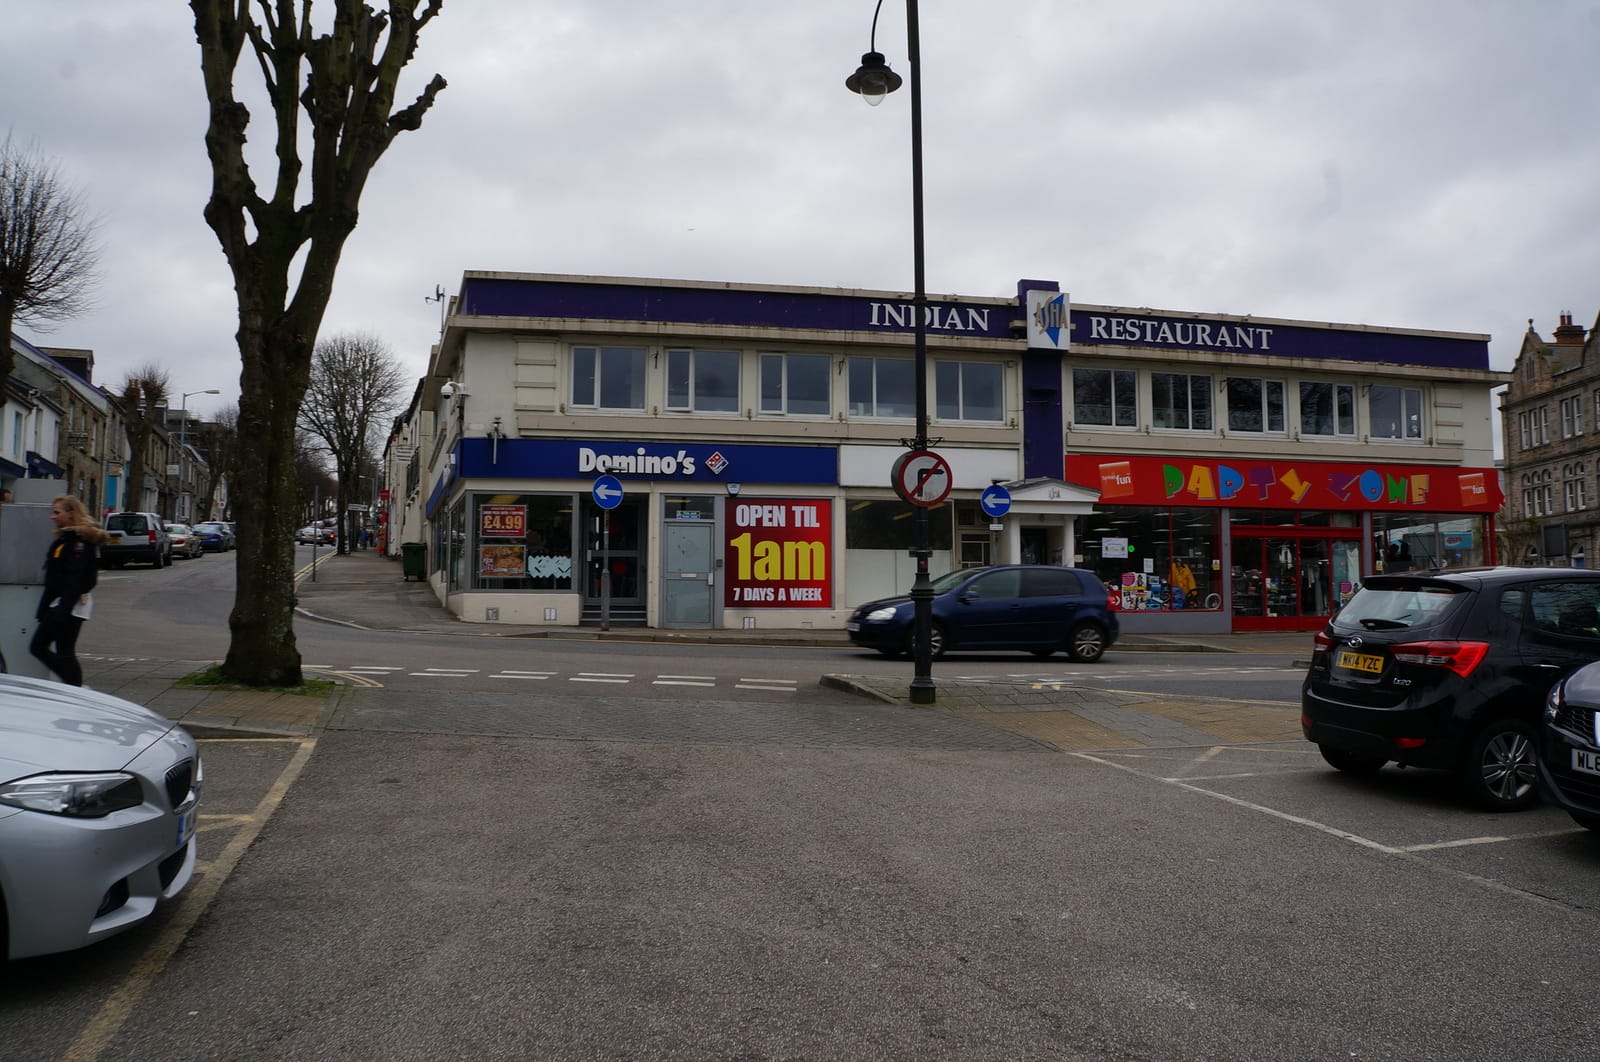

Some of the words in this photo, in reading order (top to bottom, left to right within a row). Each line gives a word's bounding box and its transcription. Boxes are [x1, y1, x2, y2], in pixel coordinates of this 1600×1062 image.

[869, 302, 990, 331] INDIAN
[1090, 316, 1273, 350] RESTAURANT
[1034, 296, 1068, 335] ASHA
[579, 447, 696, 475] Domino's
[1116, 473, 1132, 486] fun
[1162, 463, 1312, 505] PARTY
[1327, 468, 1430, 505] ZONE
[483, 515, 522, 529] £4.99
[736, 504, 786, 527] OPEN
[792, 505, 820, 528] TIL
[730, 532, 826, 581] 1am
[733, 587, 741, 601] 7
[743, 587, 775, 601] DAYS
[777, 587, 787, 601] A
[789, 587, 823, 601] WEEK
[1362, 655, 1381, 671] YZC
